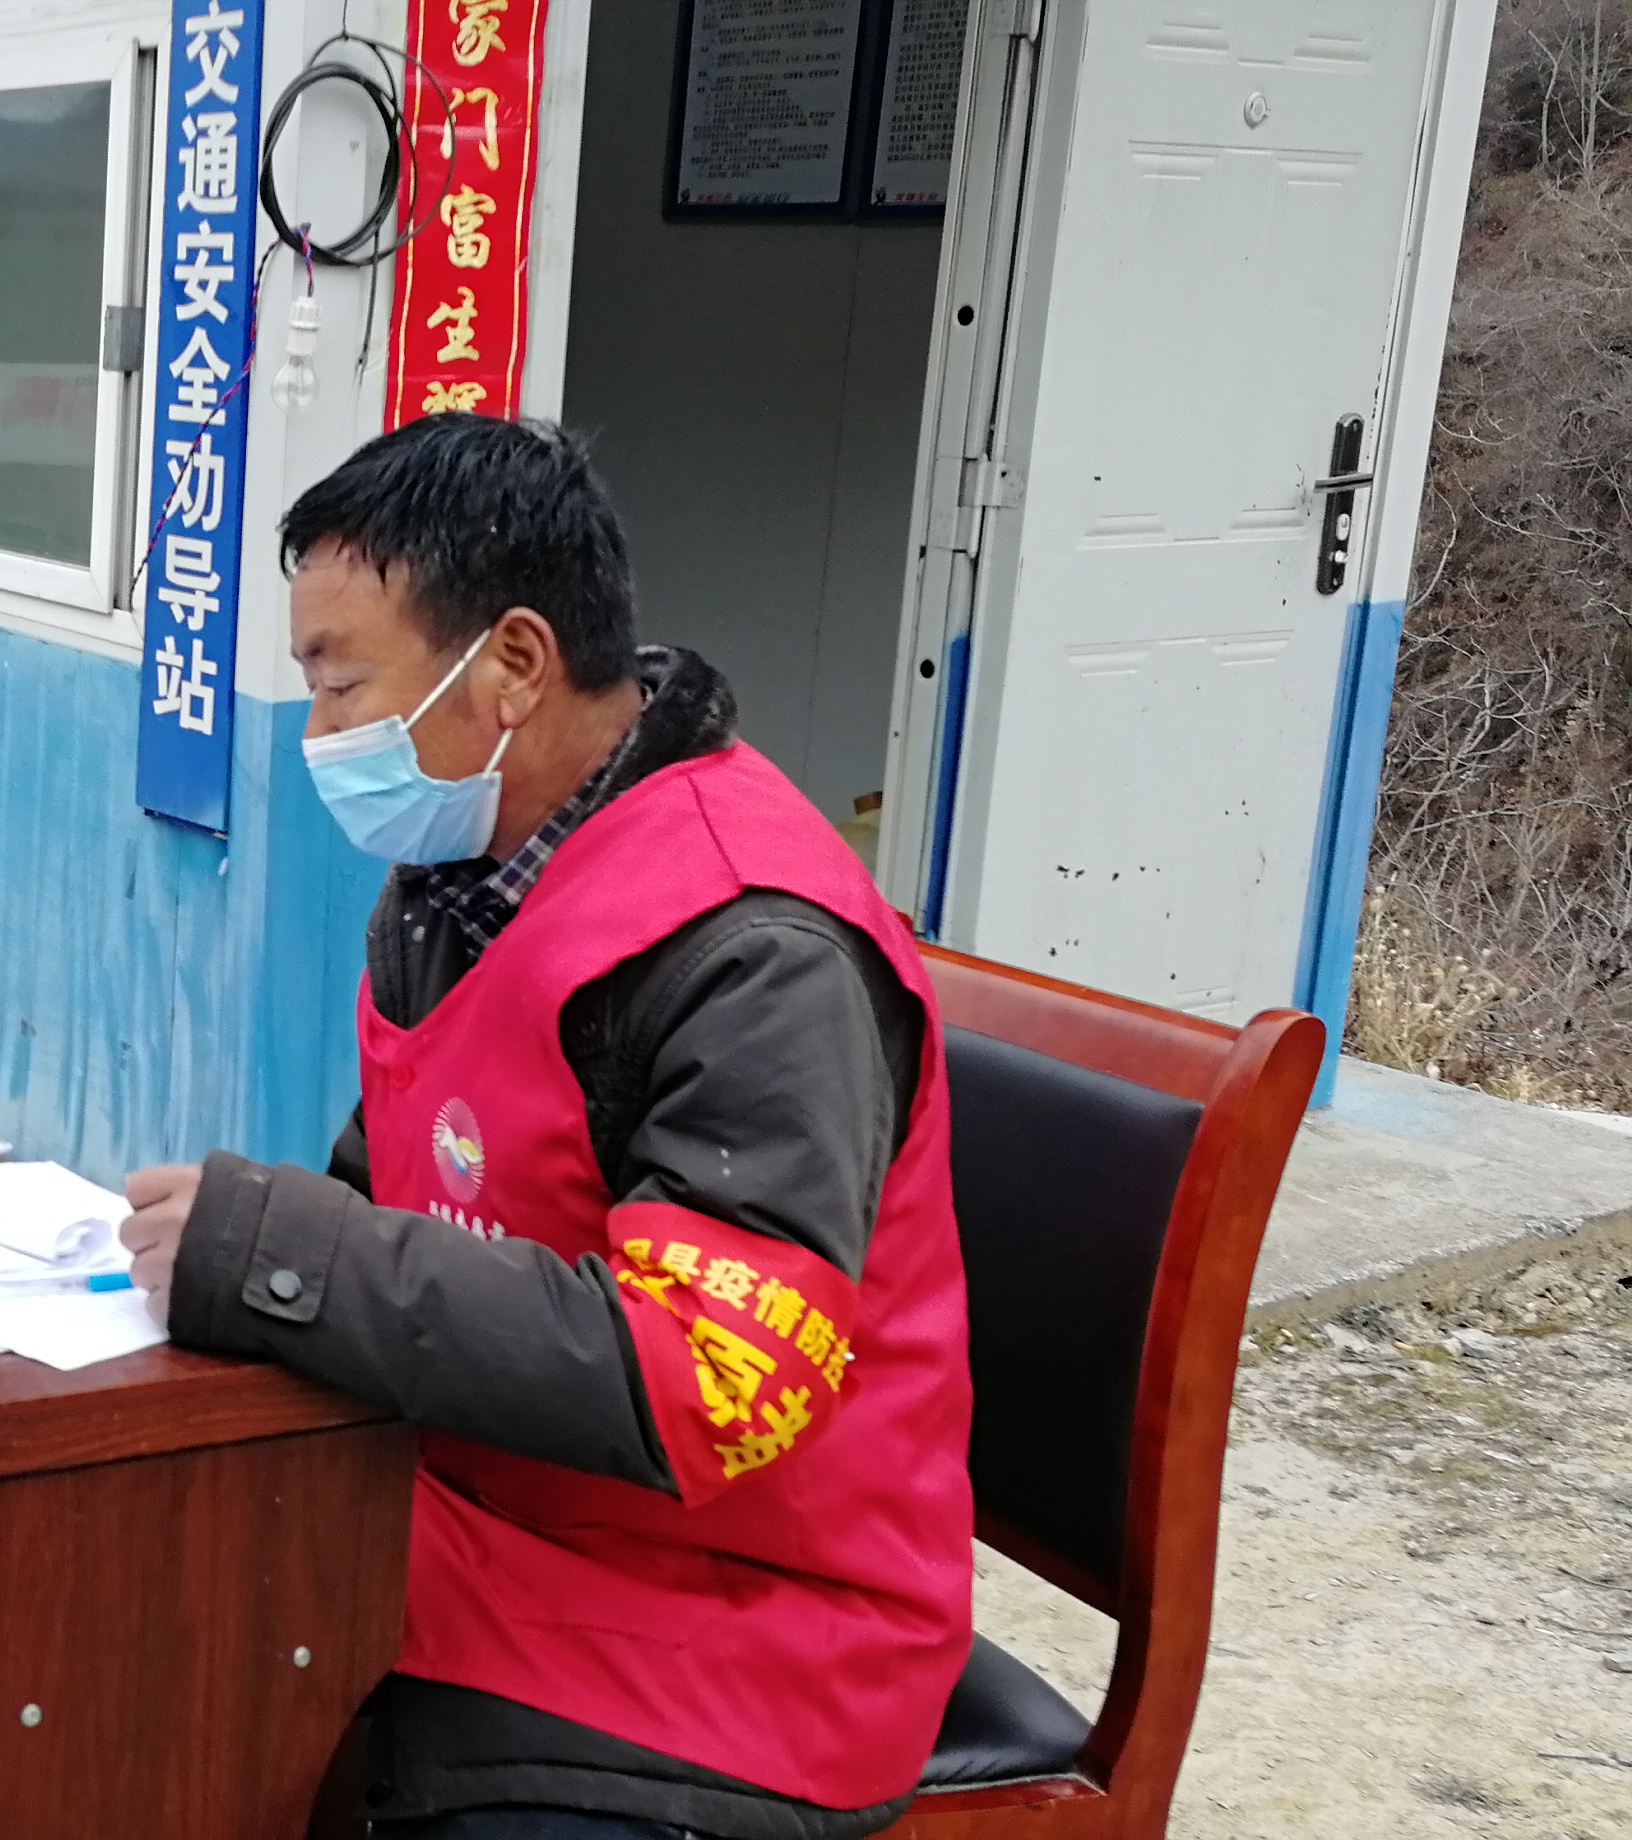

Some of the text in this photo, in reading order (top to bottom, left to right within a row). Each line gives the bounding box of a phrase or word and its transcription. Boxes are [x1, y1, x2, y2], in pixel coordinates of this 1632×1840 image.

[153, 0, 244, 736] 交通安全劝导站
